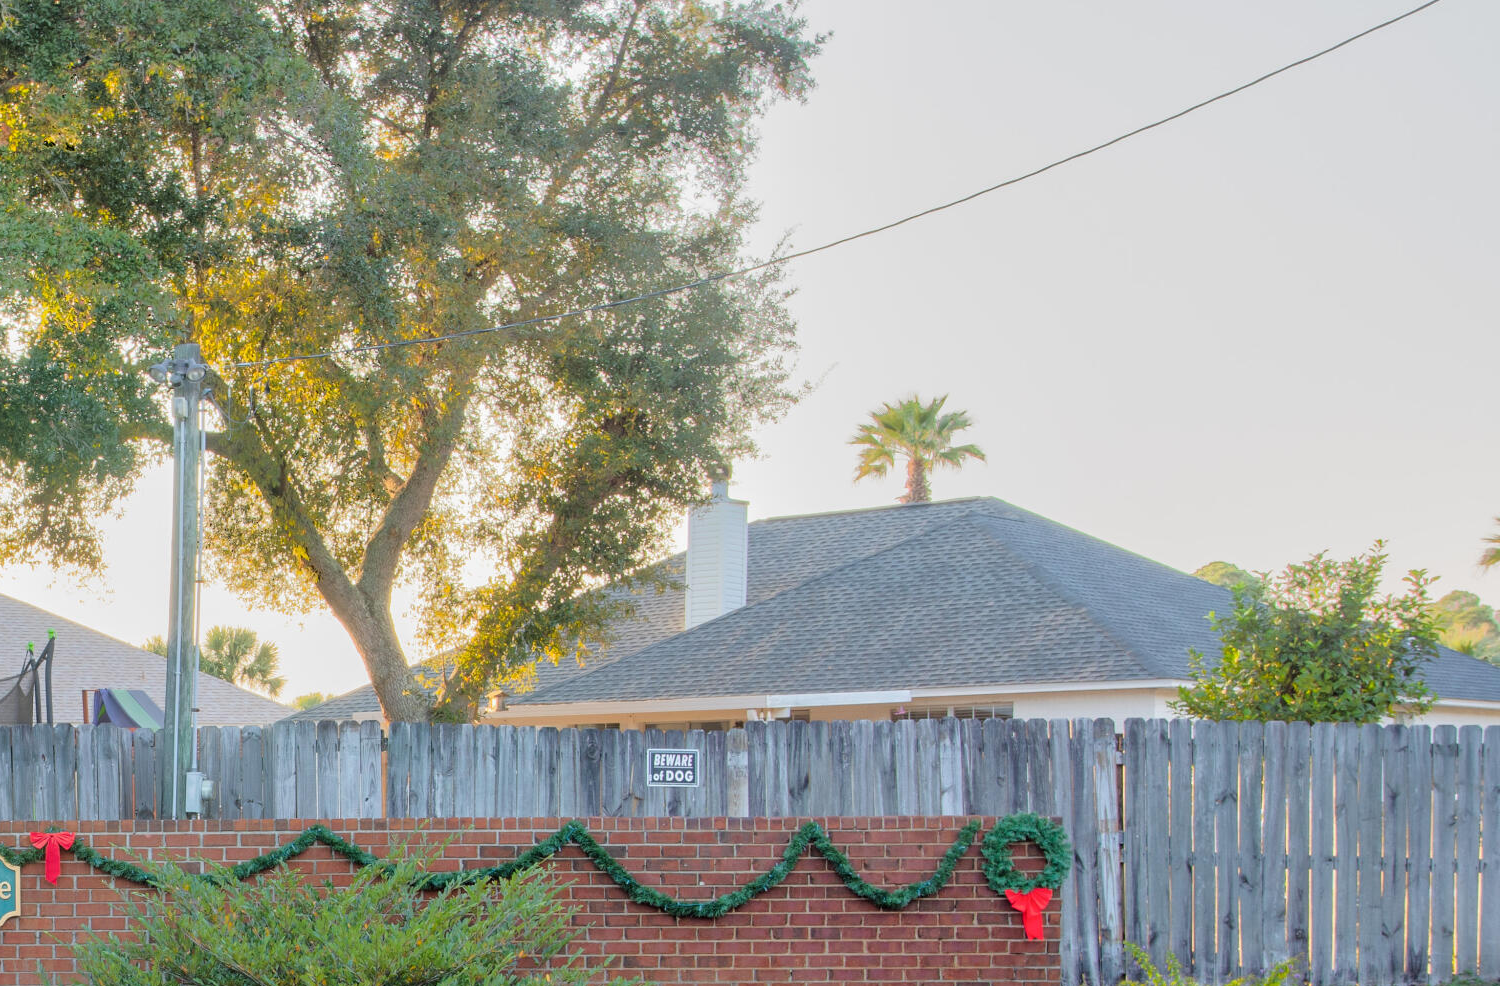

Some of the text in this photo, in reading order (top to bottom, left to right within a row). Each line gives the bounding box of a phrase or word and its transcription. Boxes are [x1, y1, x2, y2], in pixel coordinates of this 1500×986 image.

[653, 754, 693, 767] BEWARE
[653, 770, 694, 782] of DOG
